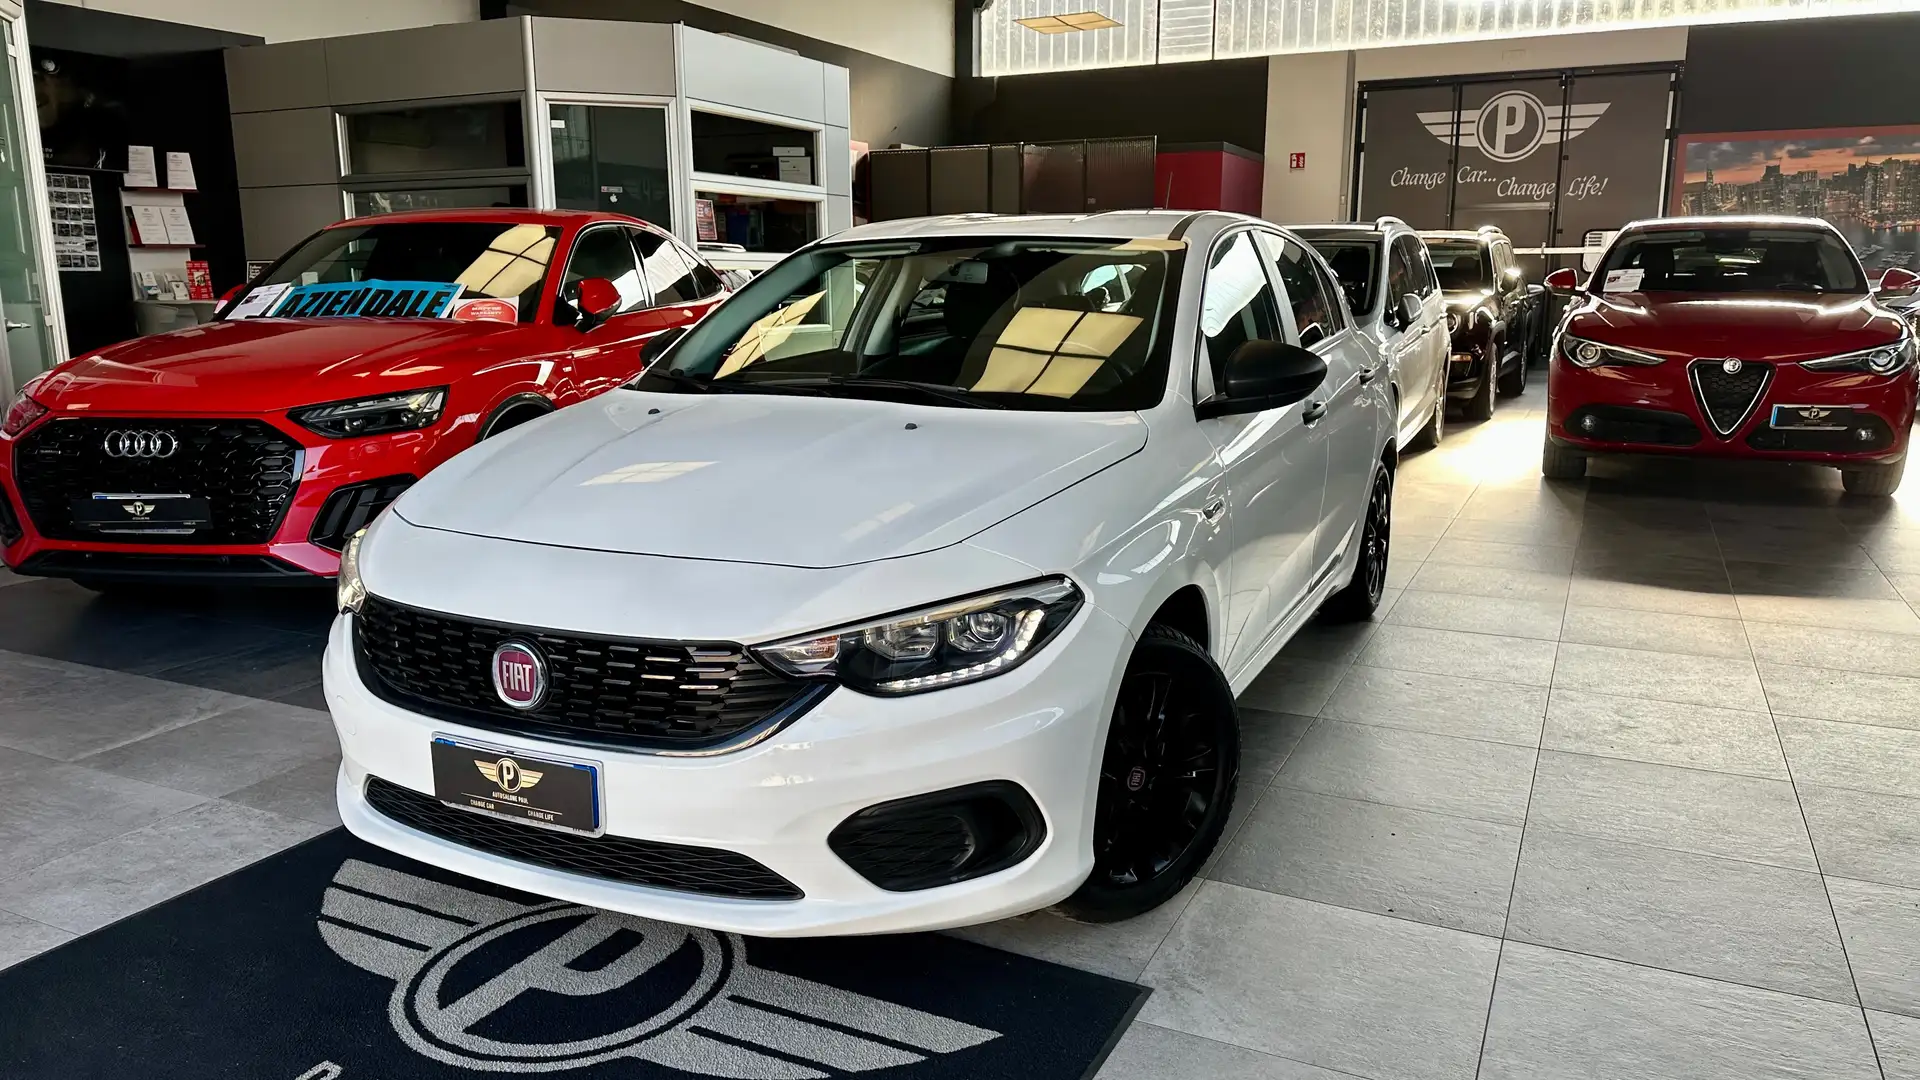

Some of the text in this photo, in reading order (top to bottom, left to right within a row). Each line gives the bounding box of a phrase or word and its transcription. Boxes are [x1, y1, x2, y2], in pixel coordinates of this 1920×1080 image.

[1390, 165, 1497, 190] Change Car...
[1497, 175, 1609, 200] Change Life!
[280, 287, 452, 318] AZIENDALE
[502, 660, 532, 692] FIAT
[502, 761, 515, 789] P
[492, 791, 529, 804] AUTOSALONE PAUL
[470, 799, 486, 809] CHANGE
[486, 802, 495, 810] CAR
[527, 810, 543, 820] CHANGE
[543, 813, 554, 822] LIFE
